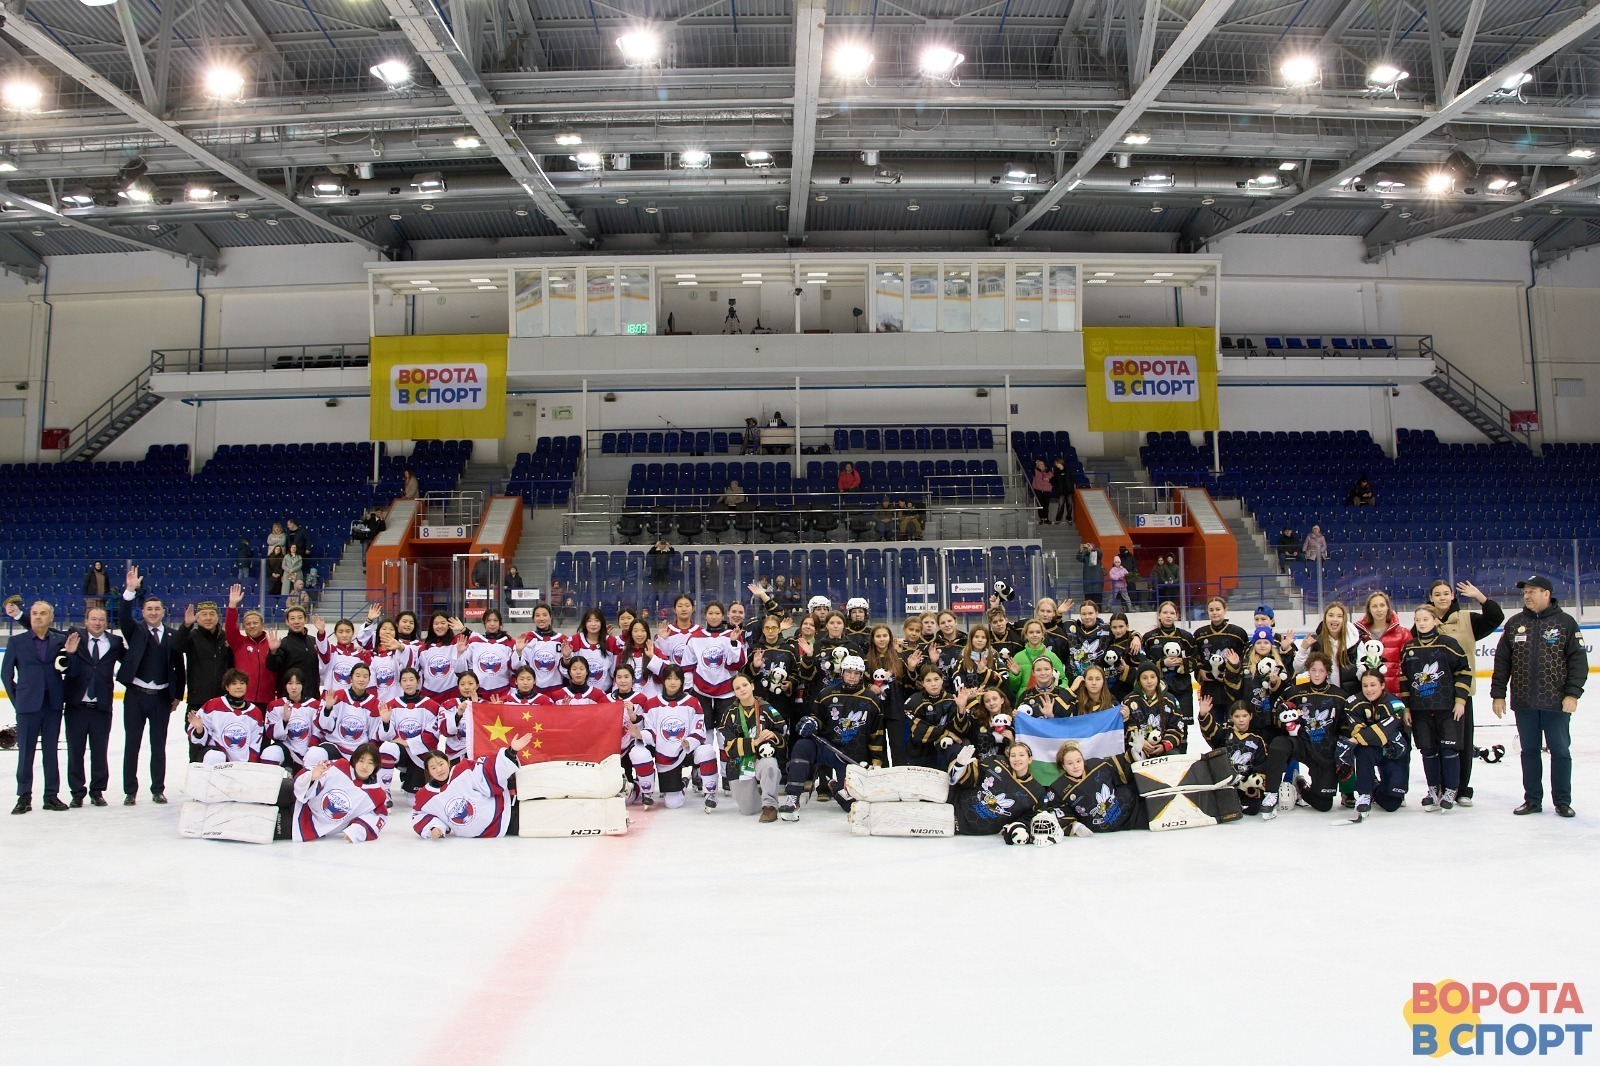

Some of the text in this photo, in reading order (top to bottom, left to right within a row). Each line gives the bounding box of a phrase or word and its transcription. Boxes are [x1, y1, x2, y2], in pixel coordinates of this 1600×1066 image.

[627, 323, 648, 334] 18:03
[1112, 360, 1191, 375] ВОРОТА
[398, 368, 478, 384] ВОРОТА
[1114, 380, 1195, 395] В СПОРТ
[398, 388, 481, 404] В СПОРТ
[1139, 516, 1146, 526] 9
[1168, 516, 1181, 526] 10
[423, 527, 429, 537] 8
[456, 527, 463, 537] 9
[1141, 756, 1168, 767] CCM
[1161, 820, 1187, 828] CCM
[570, 828, 601, 836] CCM
